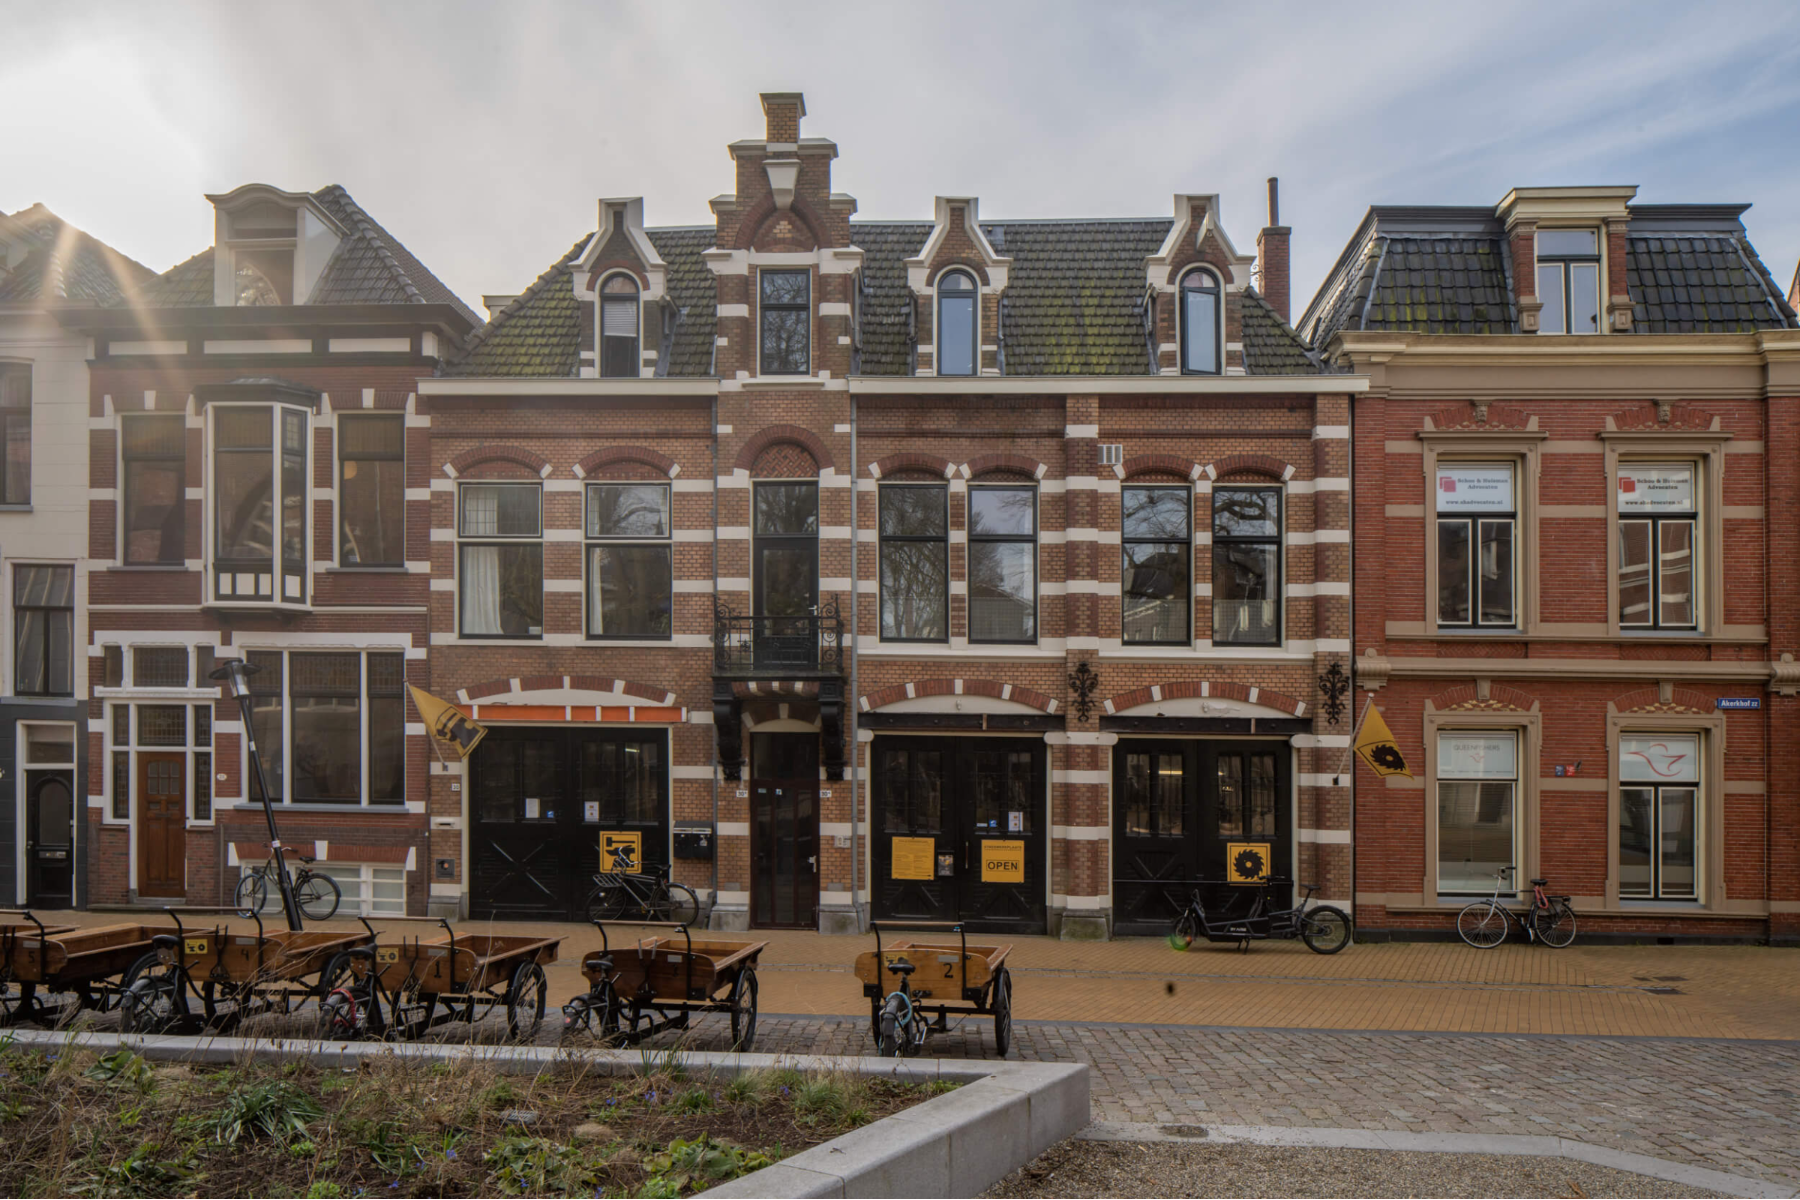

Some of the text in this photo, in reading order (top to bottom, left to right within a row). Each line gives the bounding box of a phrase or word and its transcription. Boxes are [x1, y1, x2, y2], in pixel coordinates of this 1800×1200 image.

[987, 861, 1018, 870] OPEN
[28, 951, 35, 963] 5
[241, 949, 249, 961] 4
[433, 961, 442, 978] 1
[943, 963, 953, 978] 2
